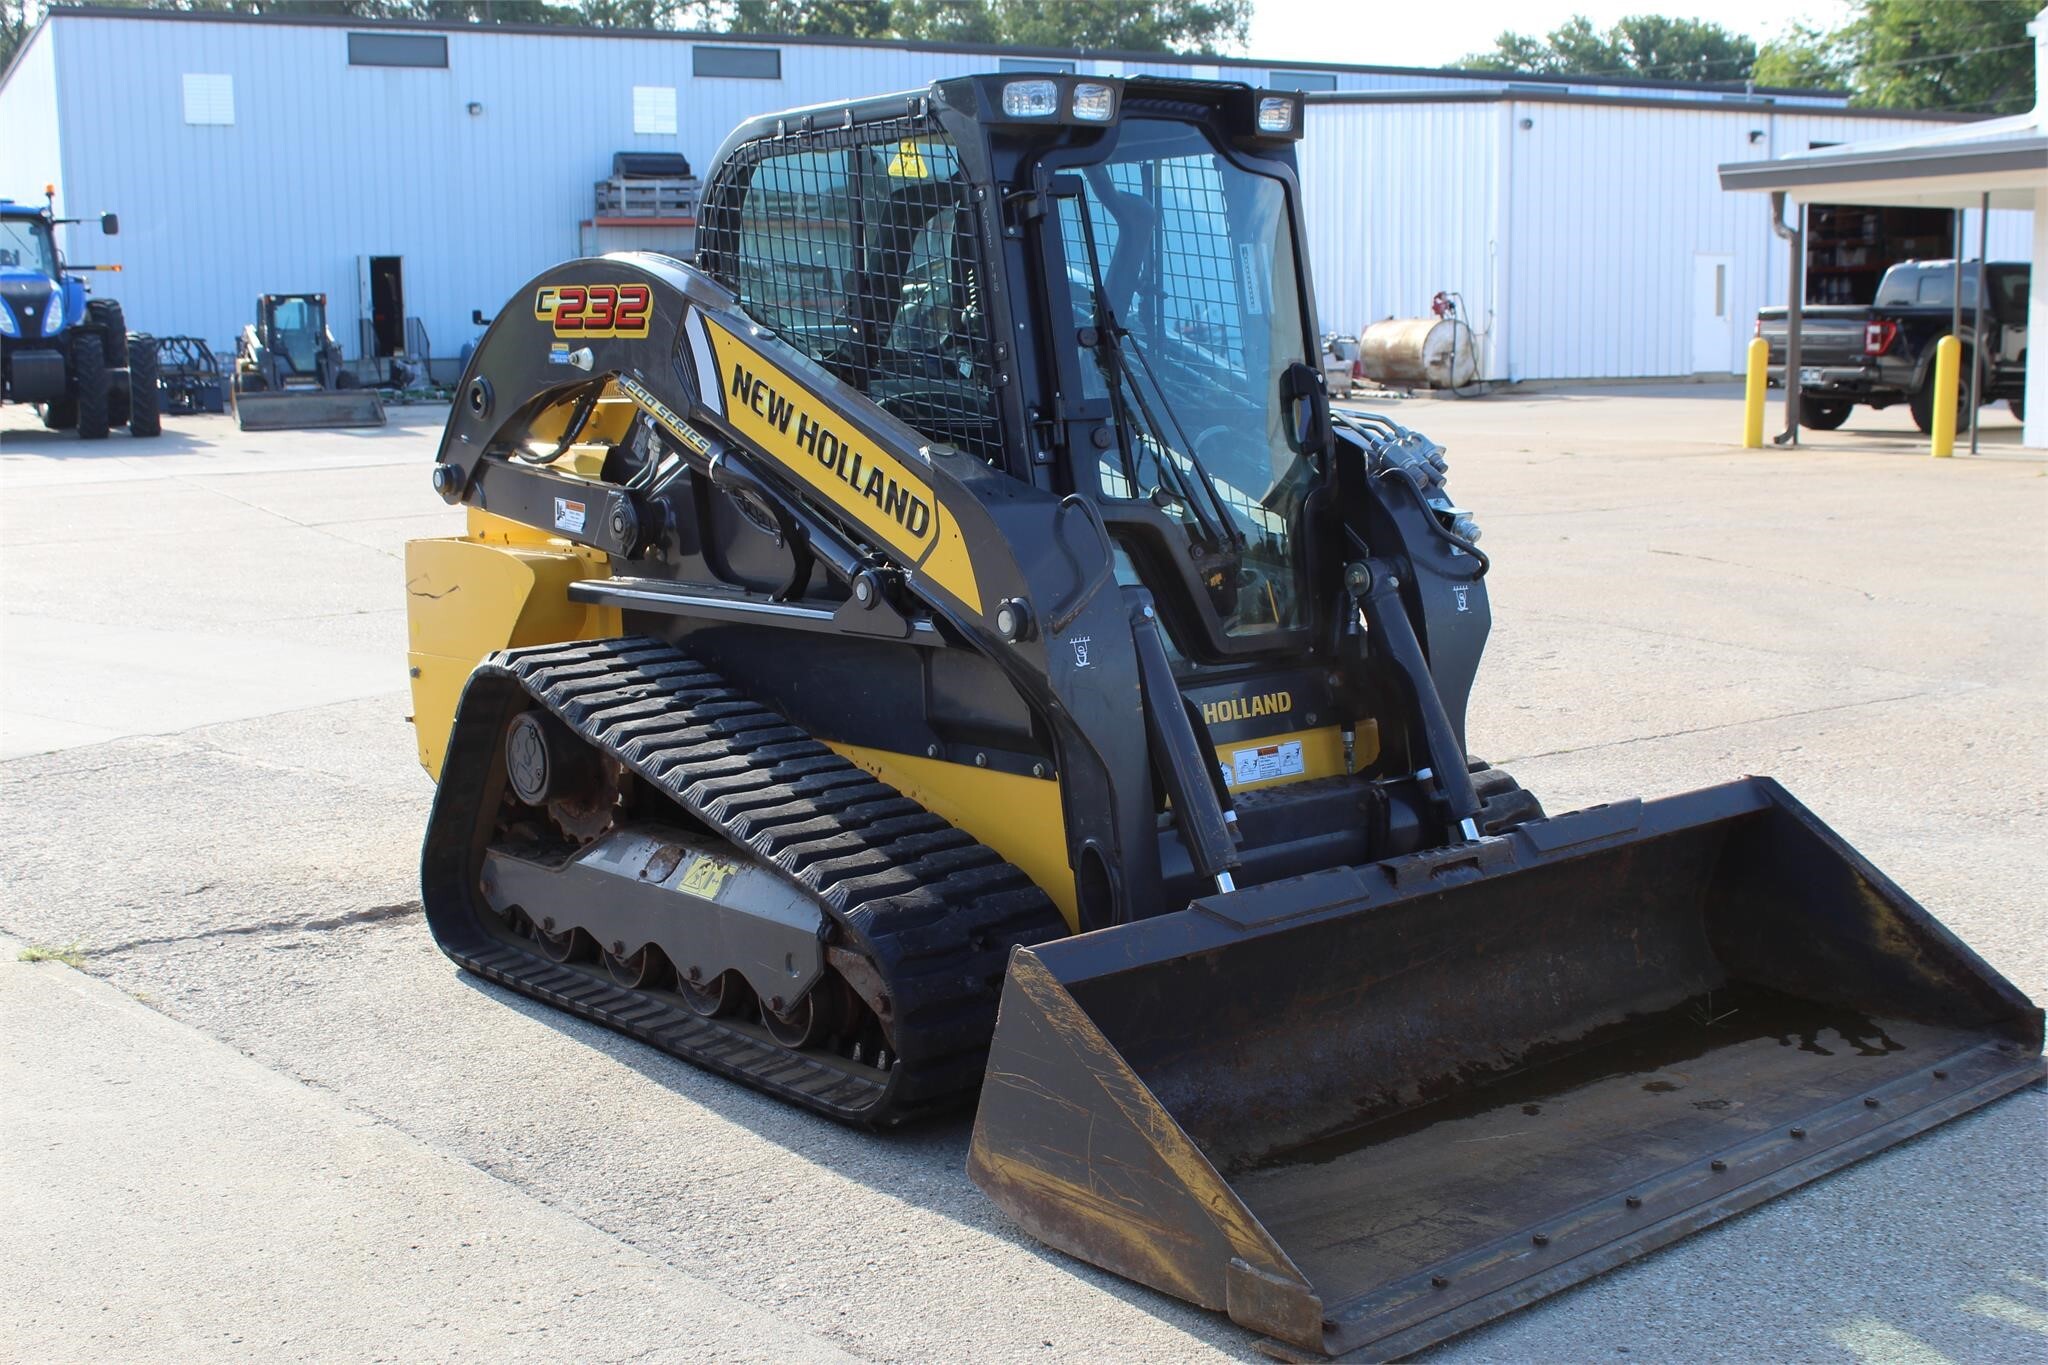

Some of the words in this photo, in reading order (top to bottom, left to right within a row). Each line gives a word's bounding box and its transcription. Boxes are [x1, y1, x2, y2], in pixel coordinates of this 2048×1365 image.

[536, 286, 651, 331] C232
[626, 381, 657, 408] 200
[655, 405, 711, 454] SERIES
[731, 363, 795, 435] NEW
[797, 412, 931, 539] HOLLAND
[1202, 691, 1292, 725] HOLLAND
